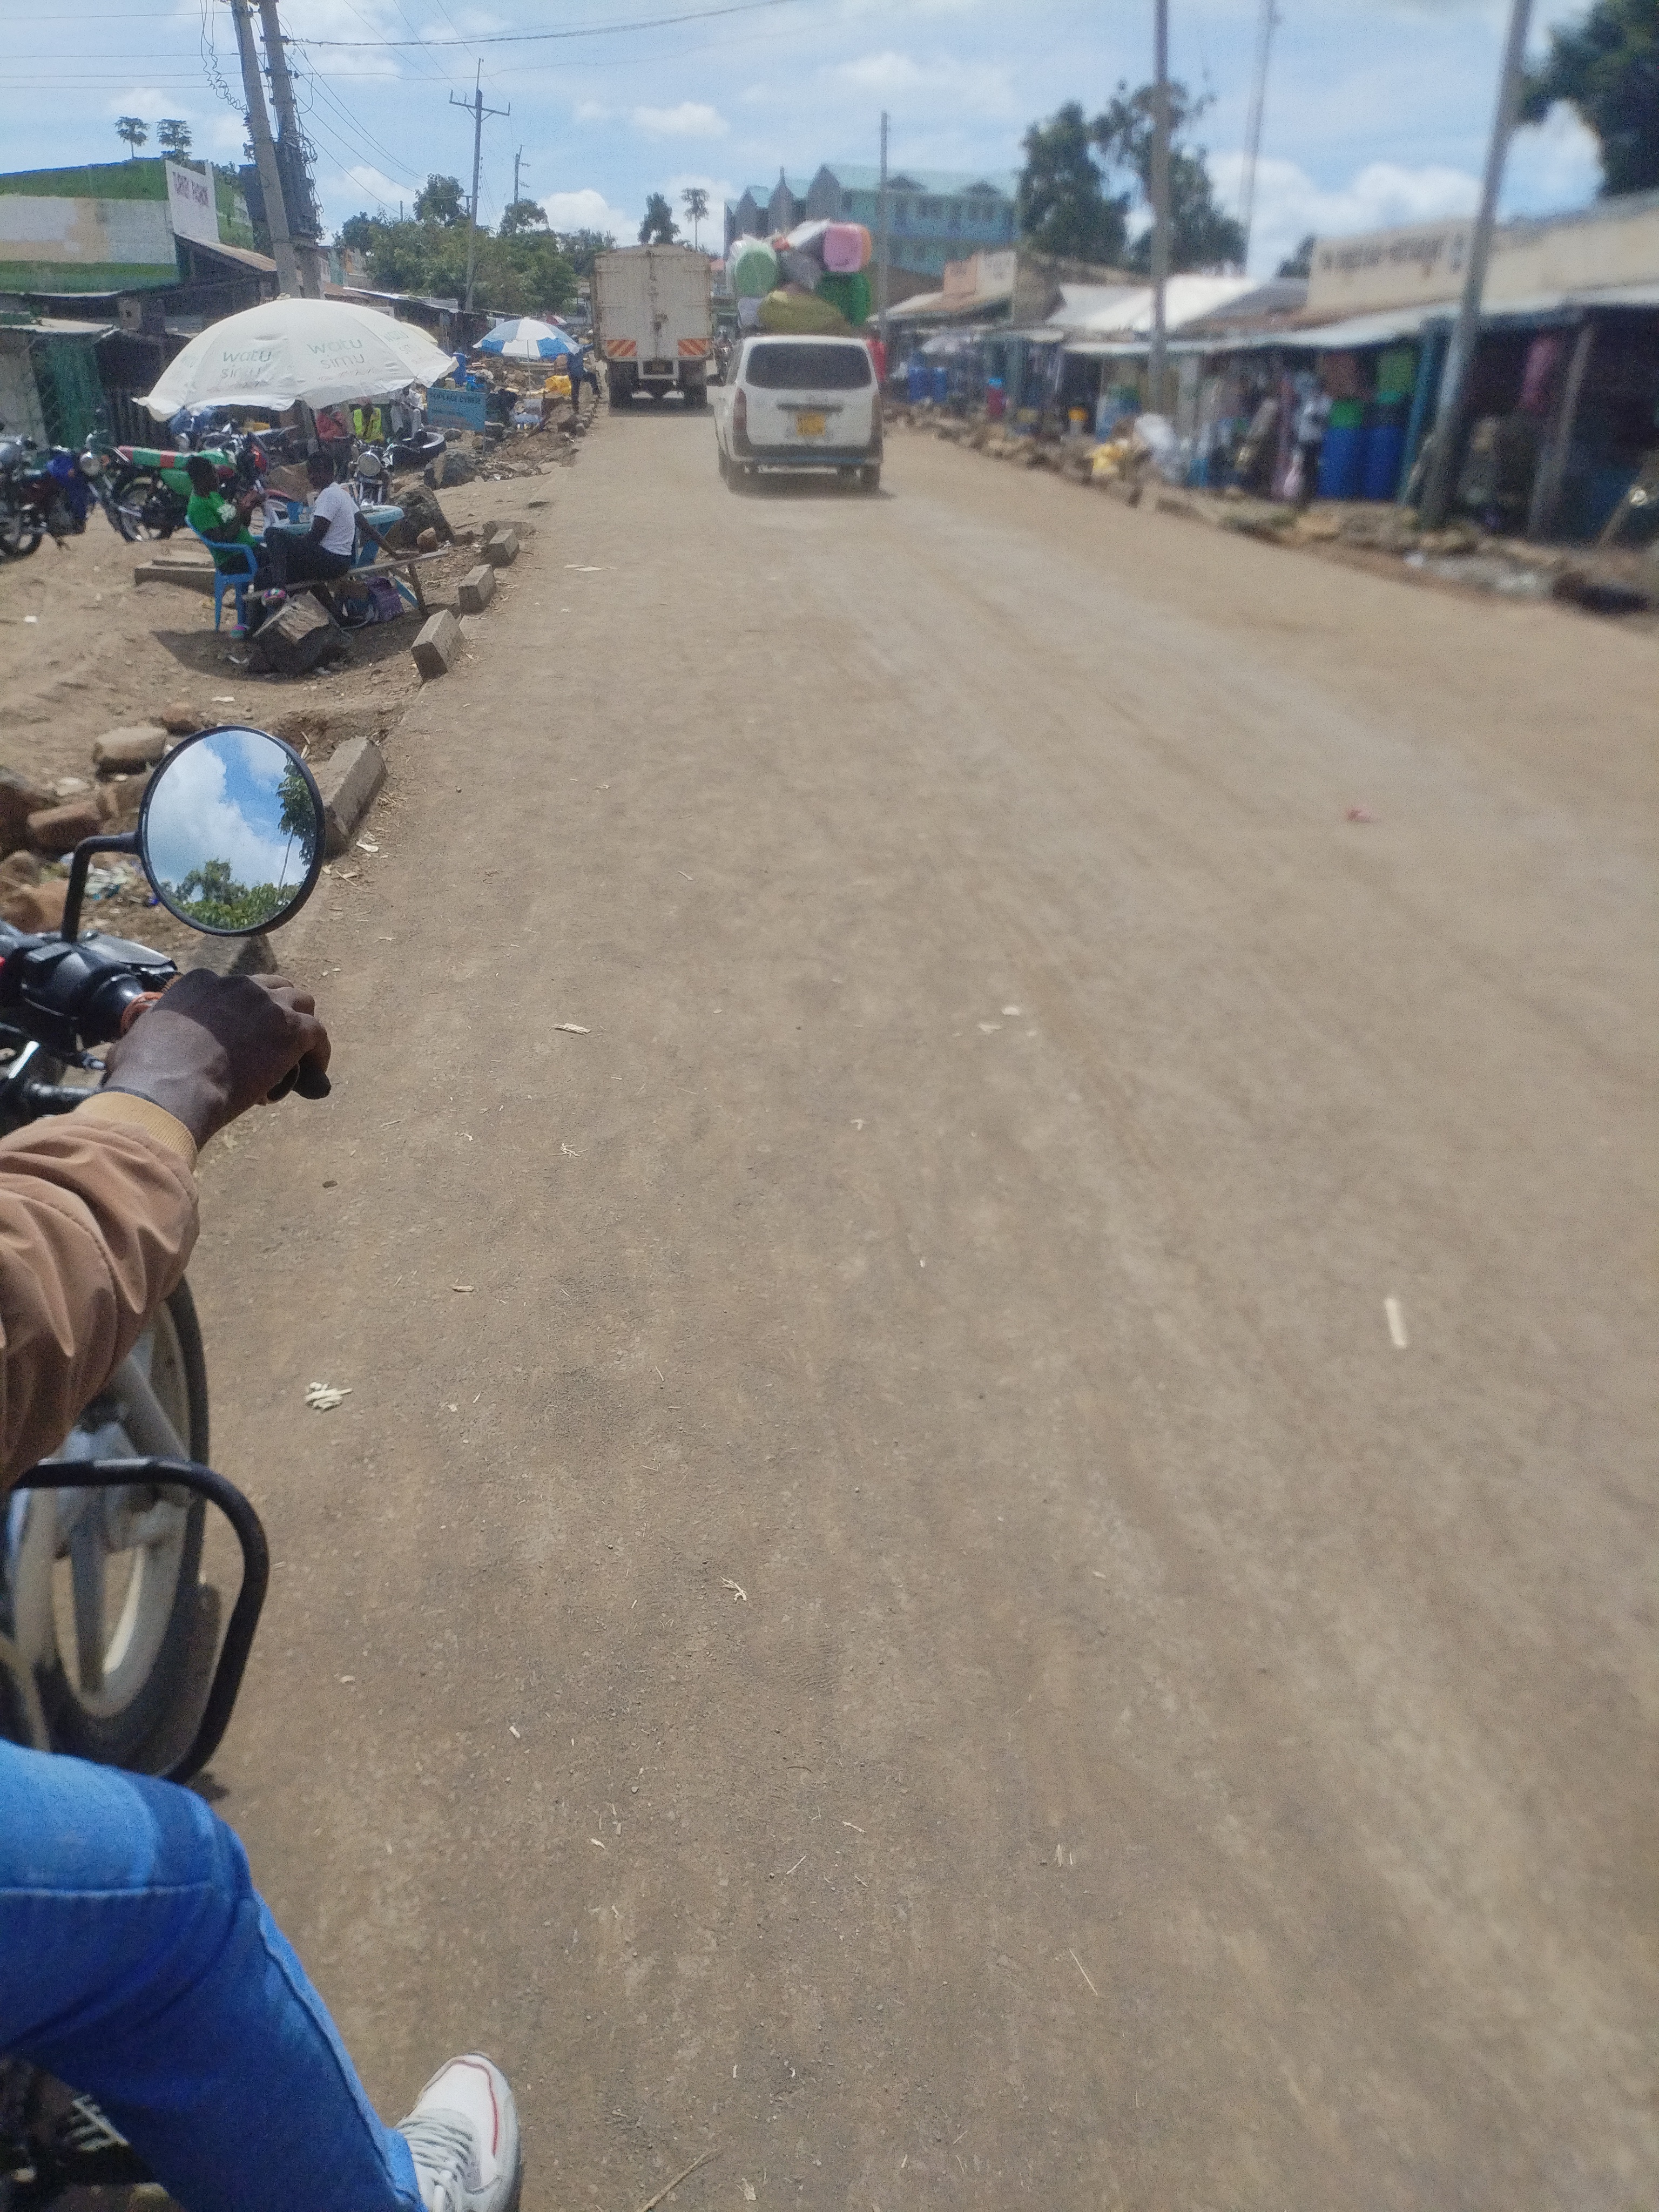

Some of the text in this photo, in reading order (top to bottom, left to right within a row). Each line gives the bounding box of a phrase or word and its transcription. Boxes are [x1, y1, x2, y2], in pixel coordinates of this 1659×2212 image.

[307, 339, 363, 354] watu
[222, 349, 272, 362] watu
[320, 354, 365, 369] simu
